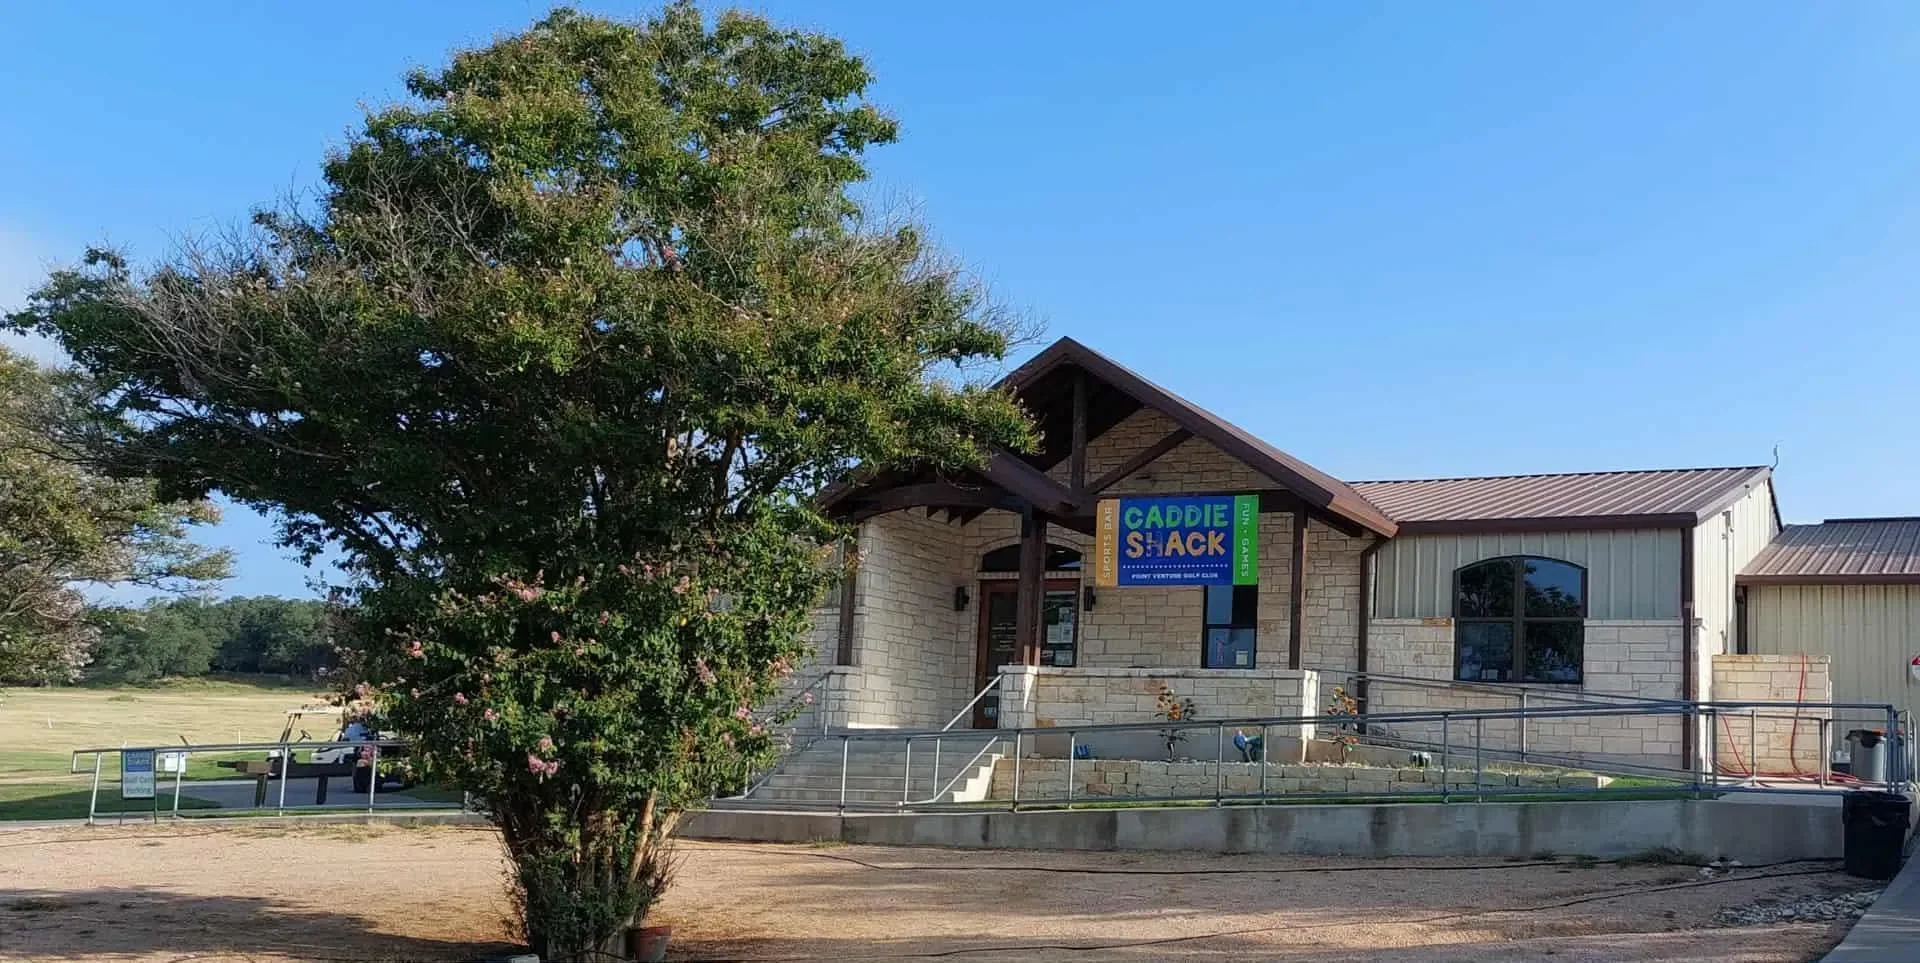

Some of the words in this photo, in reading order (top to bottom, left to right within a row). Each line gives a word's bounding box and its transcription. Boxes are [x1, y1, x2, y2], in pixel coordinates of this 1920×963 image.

[1104, 507, 1113, 530] BAR
[1124, 504, 1229, 530] CADDIE
[1241, 503, 1250, 525] FUN
[1103, 534, 1112, 578] SPORTS
[1125, 530, 1226, 559] SHACK
[1241, 539, 1250, 577] GAMES
